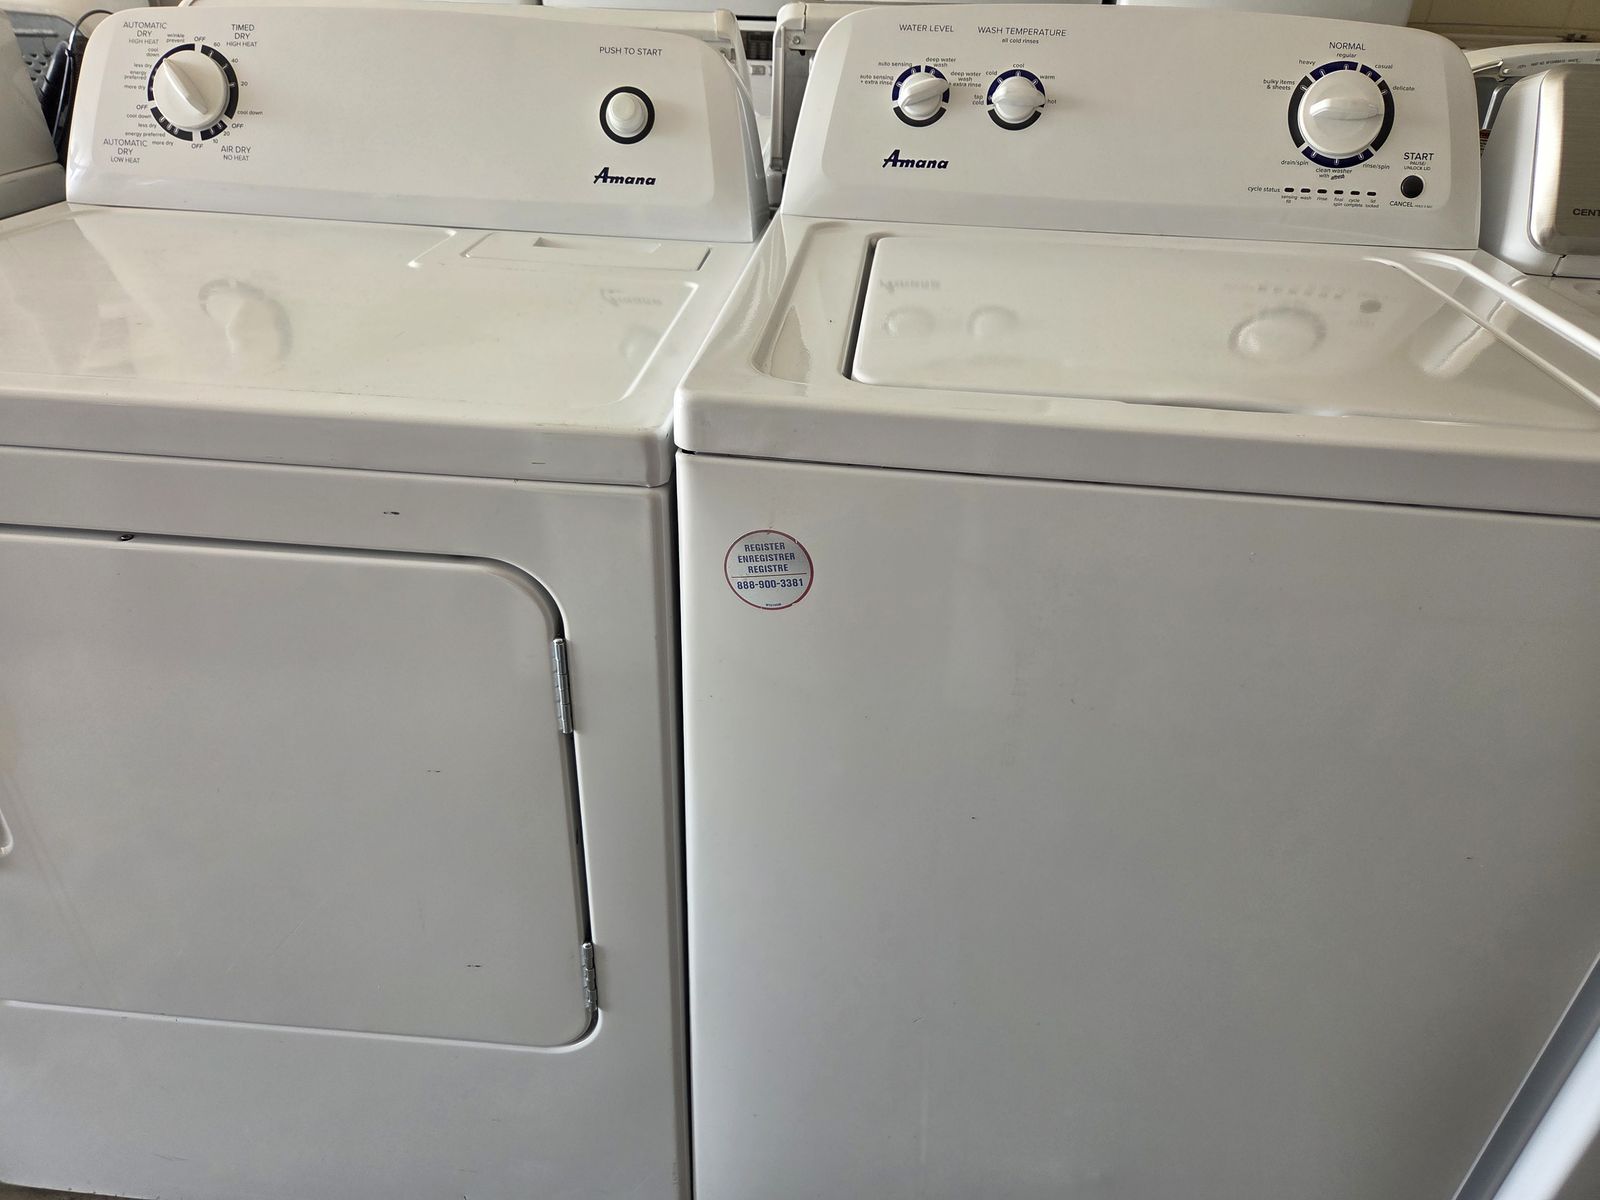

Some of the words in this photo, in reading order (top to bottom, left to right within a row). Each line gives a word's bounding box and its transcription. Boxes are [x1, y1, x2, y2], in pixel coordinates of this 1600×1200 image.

[899, 24, 928, 32] WATER
[978, 26, 1003, 34] WASH
[1006, 27, 1066, 36] TEMPERATURE
[1329, 42, 1365, 50] NORMAL
[637, 48, 662, 56] START
[103, 139, 147, 147] AUTOMATIC
[882, 149, 949, 169] Amana
[1404, 152, 1434, 160] START
[1363, 163, 1390, 171] rinse/spin
[593, 167, 656, 185] Amana
[1573, 208, 1600, 216] CENT
[744, 543, 785, 552] REGISTER
[738, 553, 795, 563] ENREGISTRER
[748, 564, 789, 573] REGISTRE
[737, 579, 803, 589] 888-900-3381
